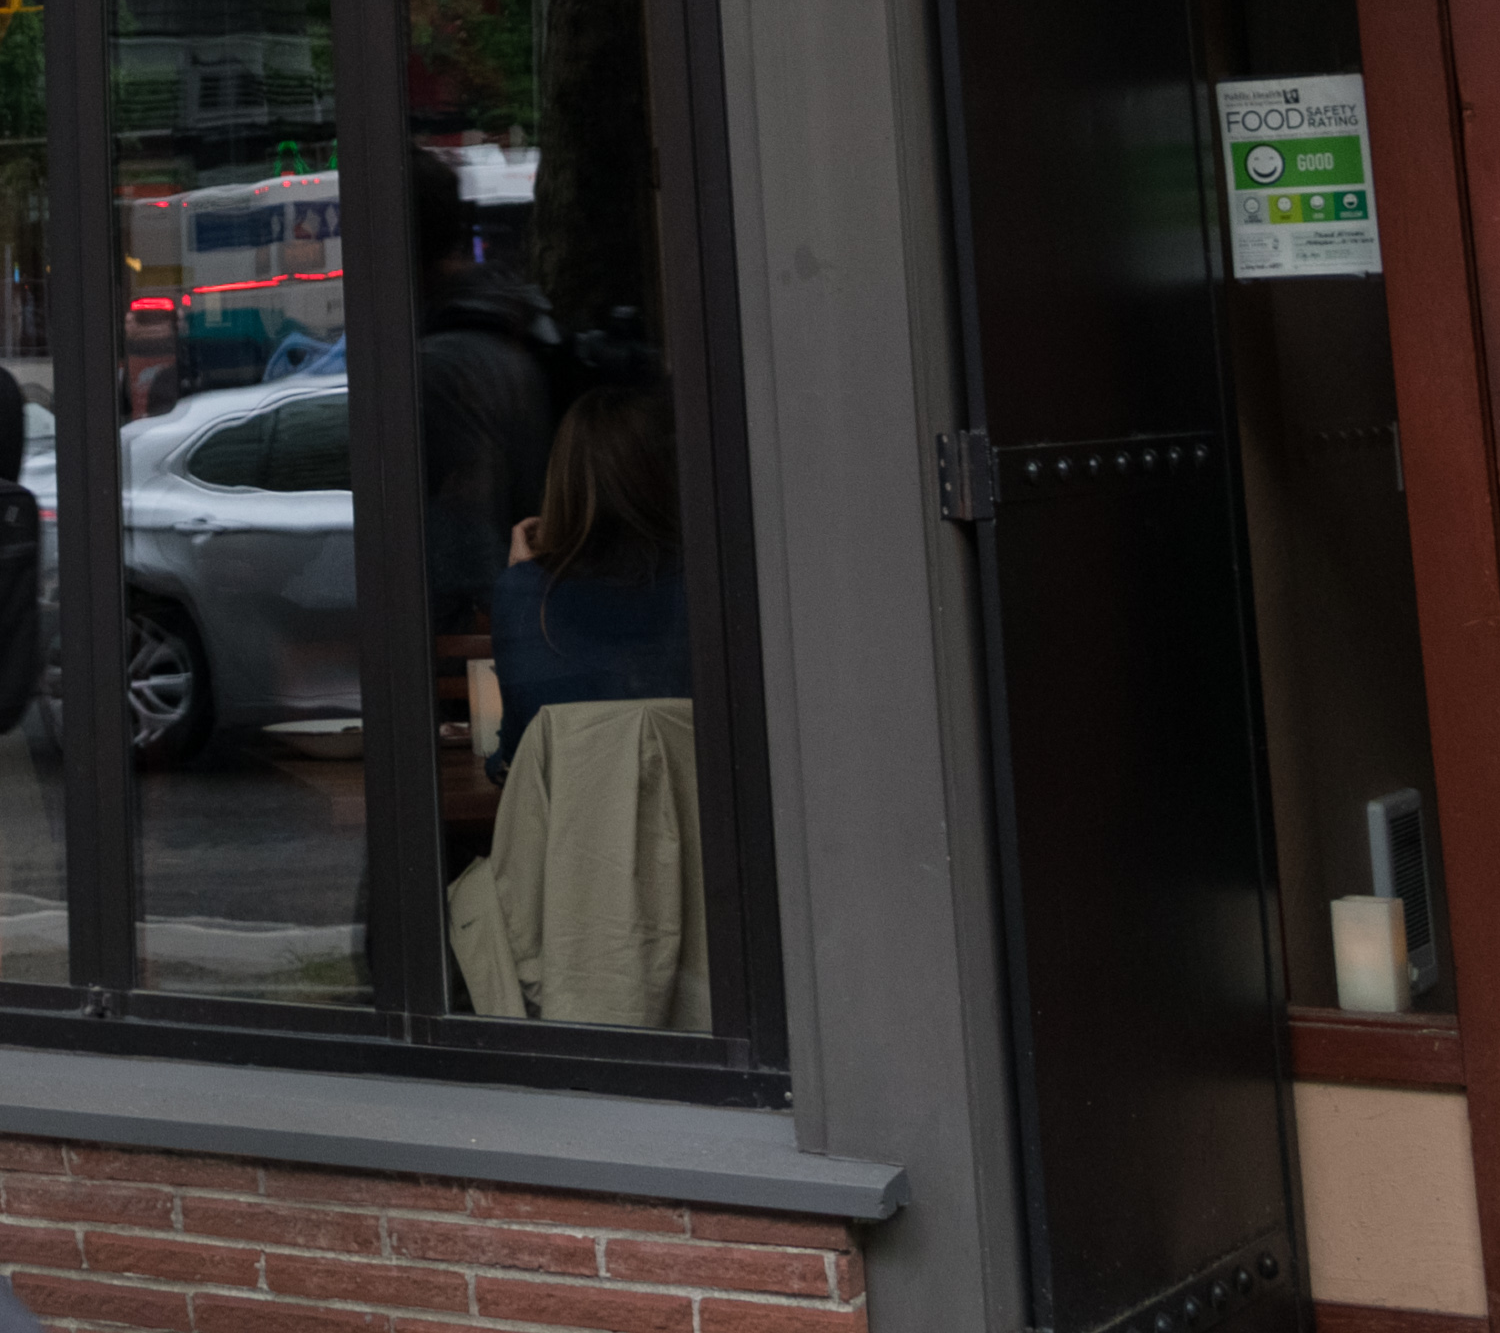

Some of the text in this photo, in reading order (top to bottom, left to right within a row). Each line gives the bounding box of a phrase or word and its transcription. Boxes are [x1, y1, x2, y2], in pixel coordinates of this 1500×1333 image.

[1306, 104, 1356, 117] SAFETY
[1226, 108, 1304, 133] FOOD
[1307, 115, 1358, 128] RATING
[1296, 152, 1334, 171] GOOD
